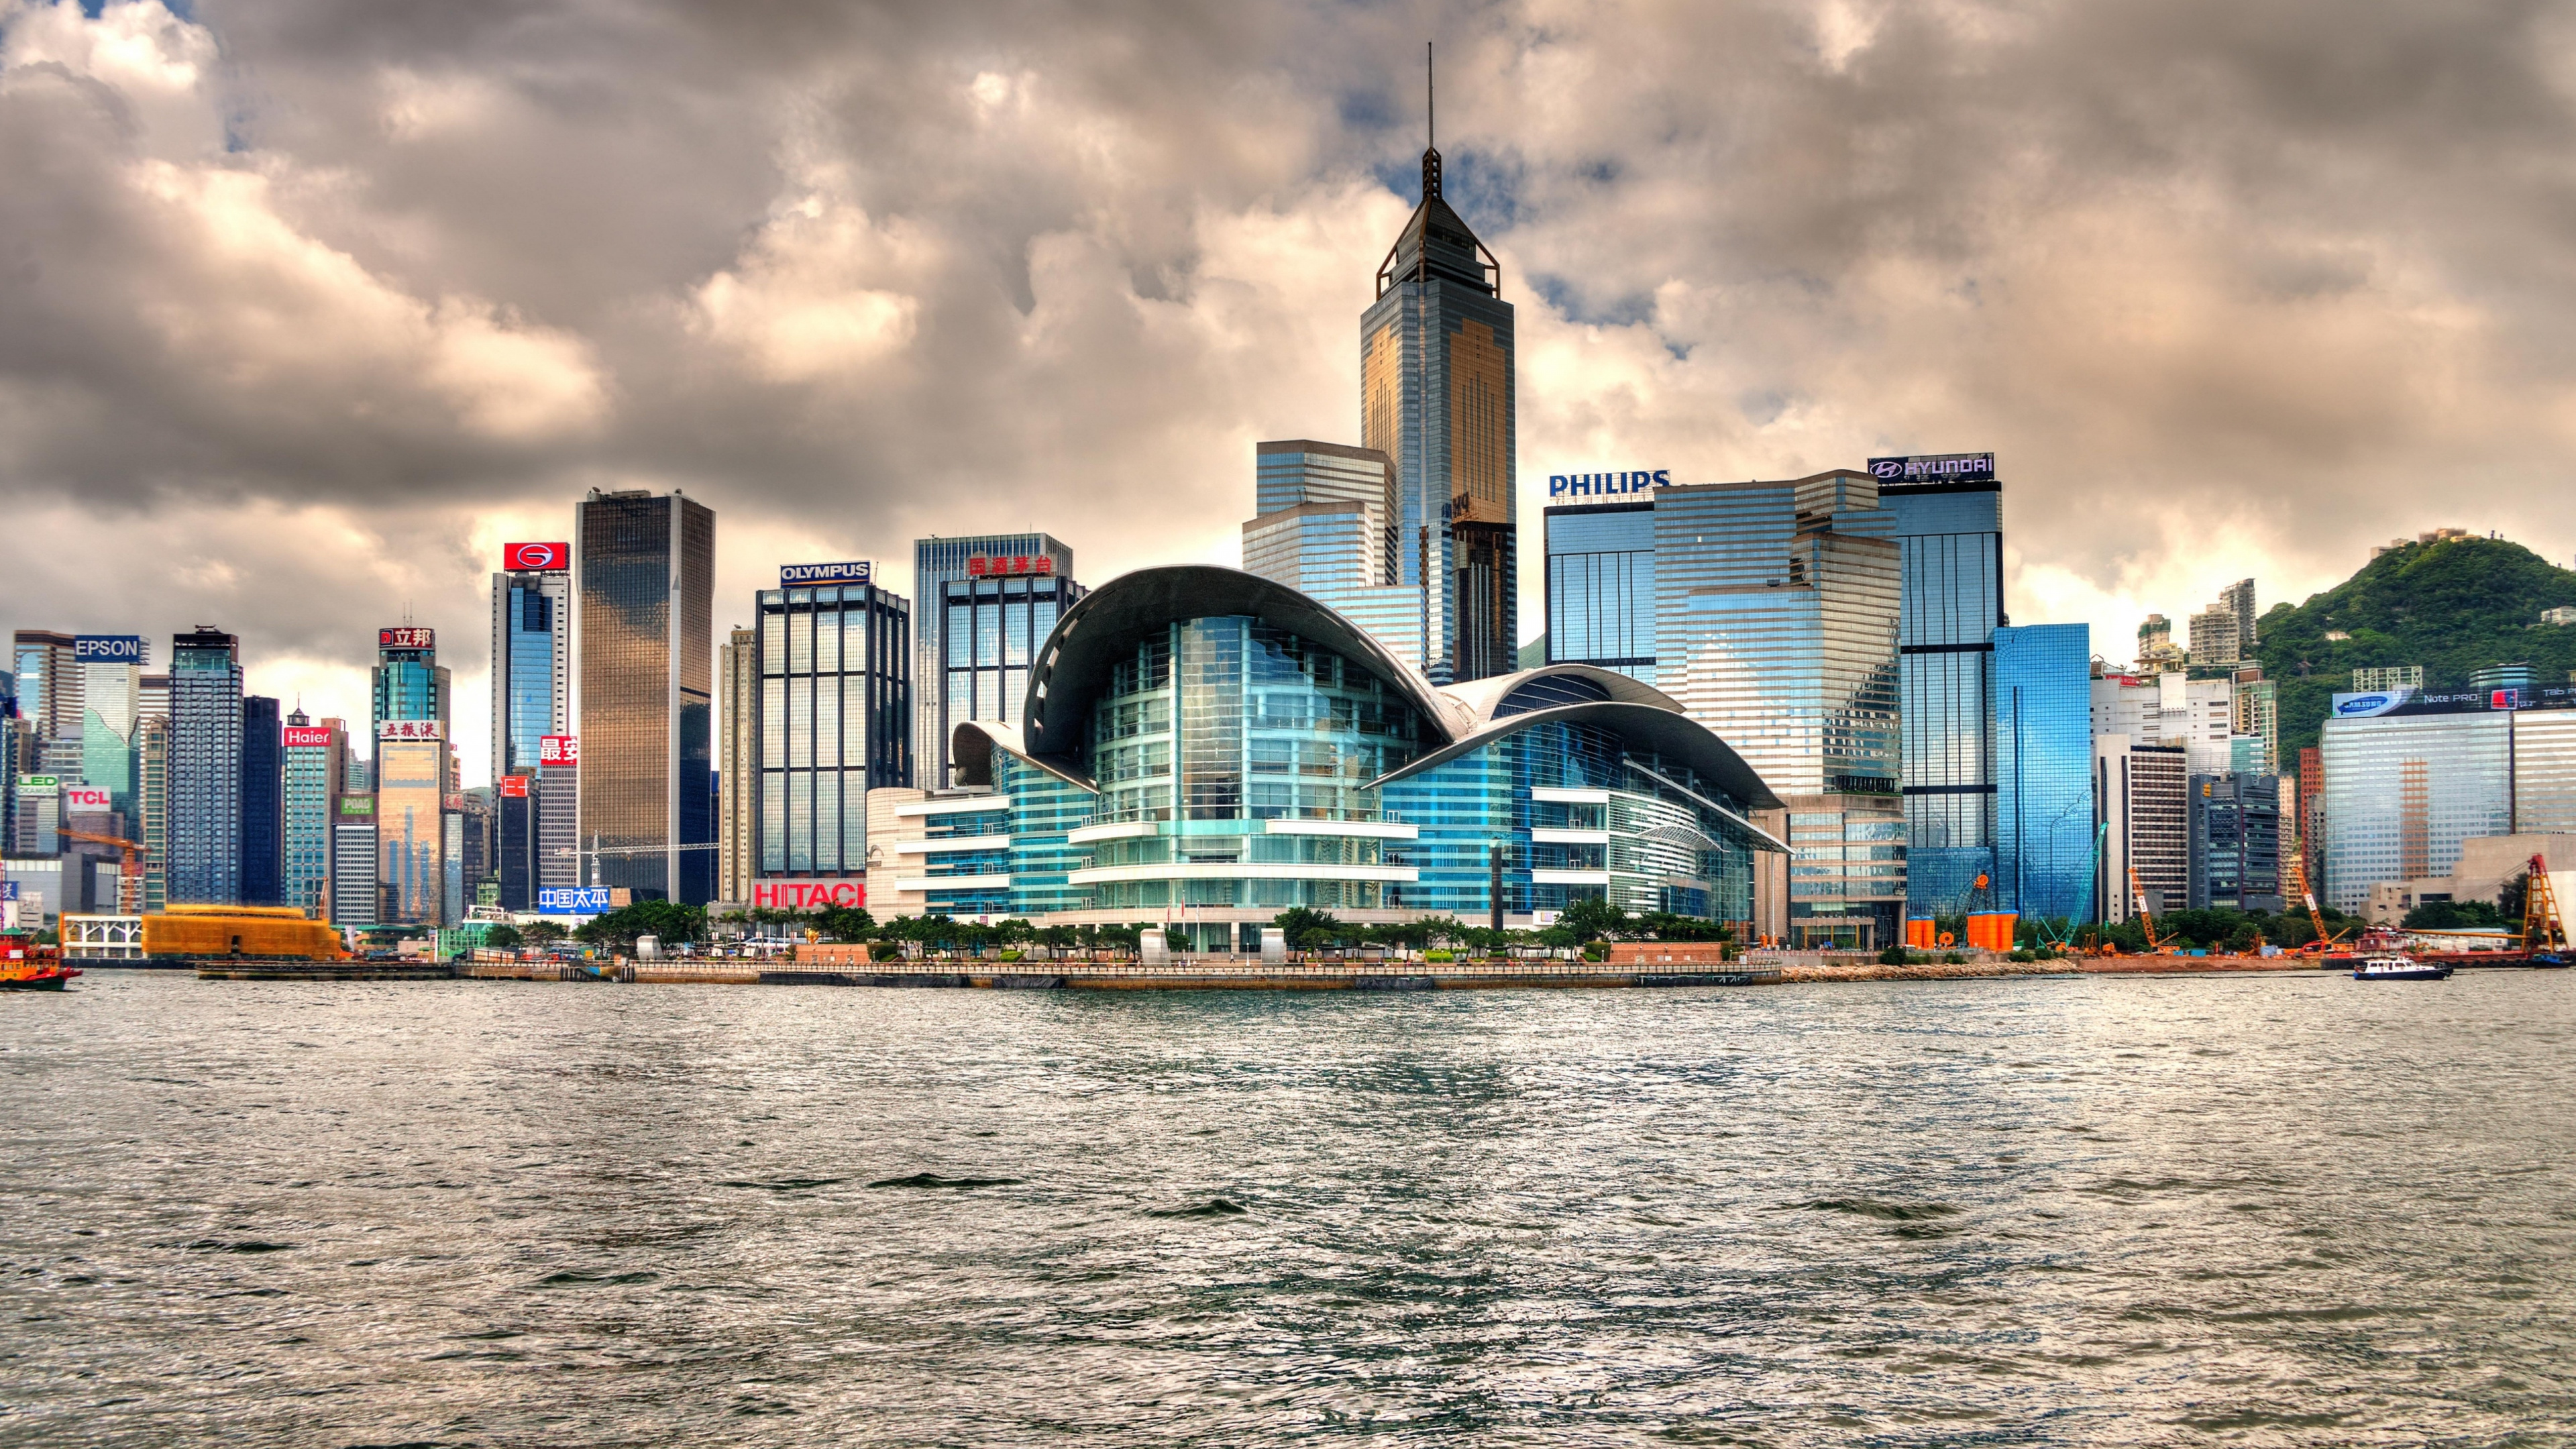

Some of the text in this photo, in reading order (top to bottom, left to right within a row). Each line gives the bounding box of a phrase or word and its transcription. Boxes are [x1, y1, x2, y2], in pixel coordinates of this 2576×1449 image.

[1904, 458, 1993, 476] HYUNDAI
[1550, 470, 1670, 497] PHILIPS
[782, 564, 869, 580] OLYMPUS
[969, 555, 1051, 575] 国酒茅台
[394, 629, 431, 647] 立邦
[76, 640, 138, 655] EPSON
[2424, 694, 2478, 704] Note PRO
[288, 731, 329, 743] Haier
[18, 776, 58, 786] LED
[69, 791, 109, 804] TCL
[345, 798, 371, 809] POAD
[539, 888, 608, 908] 中国太平
